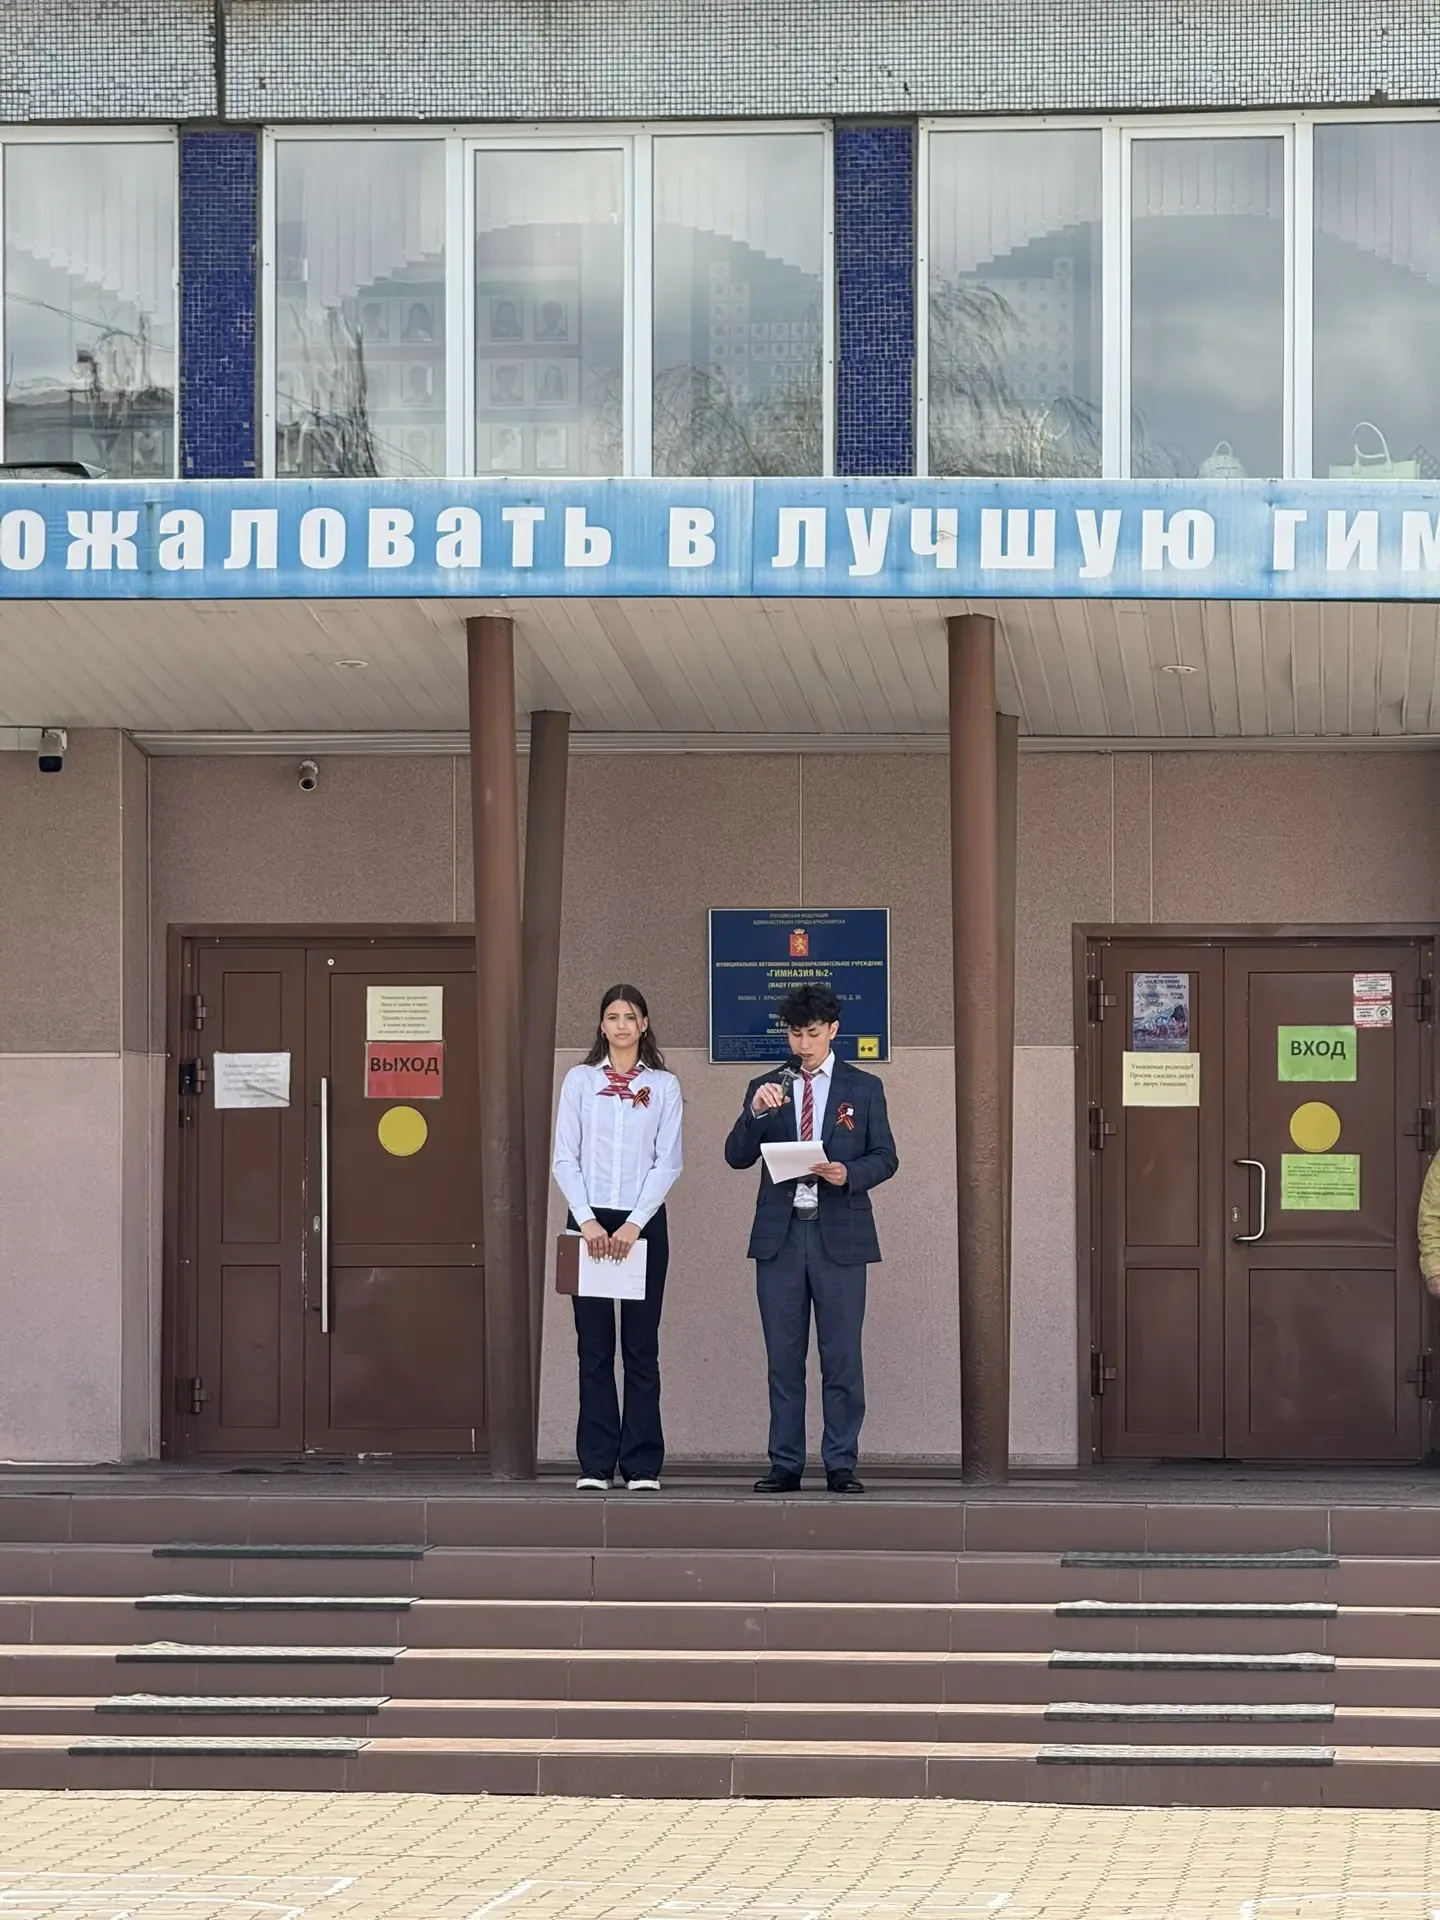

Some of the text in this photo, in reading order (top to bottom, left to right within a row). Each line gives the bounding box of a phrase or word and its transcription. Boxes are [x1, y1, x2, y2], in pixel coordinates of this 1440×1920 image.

[0, 506, 612, 570] ожаловать
[668, 506, 717, 567] в
[771, 507, 1216, 577] лучшую
[766, 969, 814, 977] «ГИМНАЗИЯ
[1290, 1040, 1347, 1060] ВХОД
[370, 1057, 440, 1075] ВЫХОД
